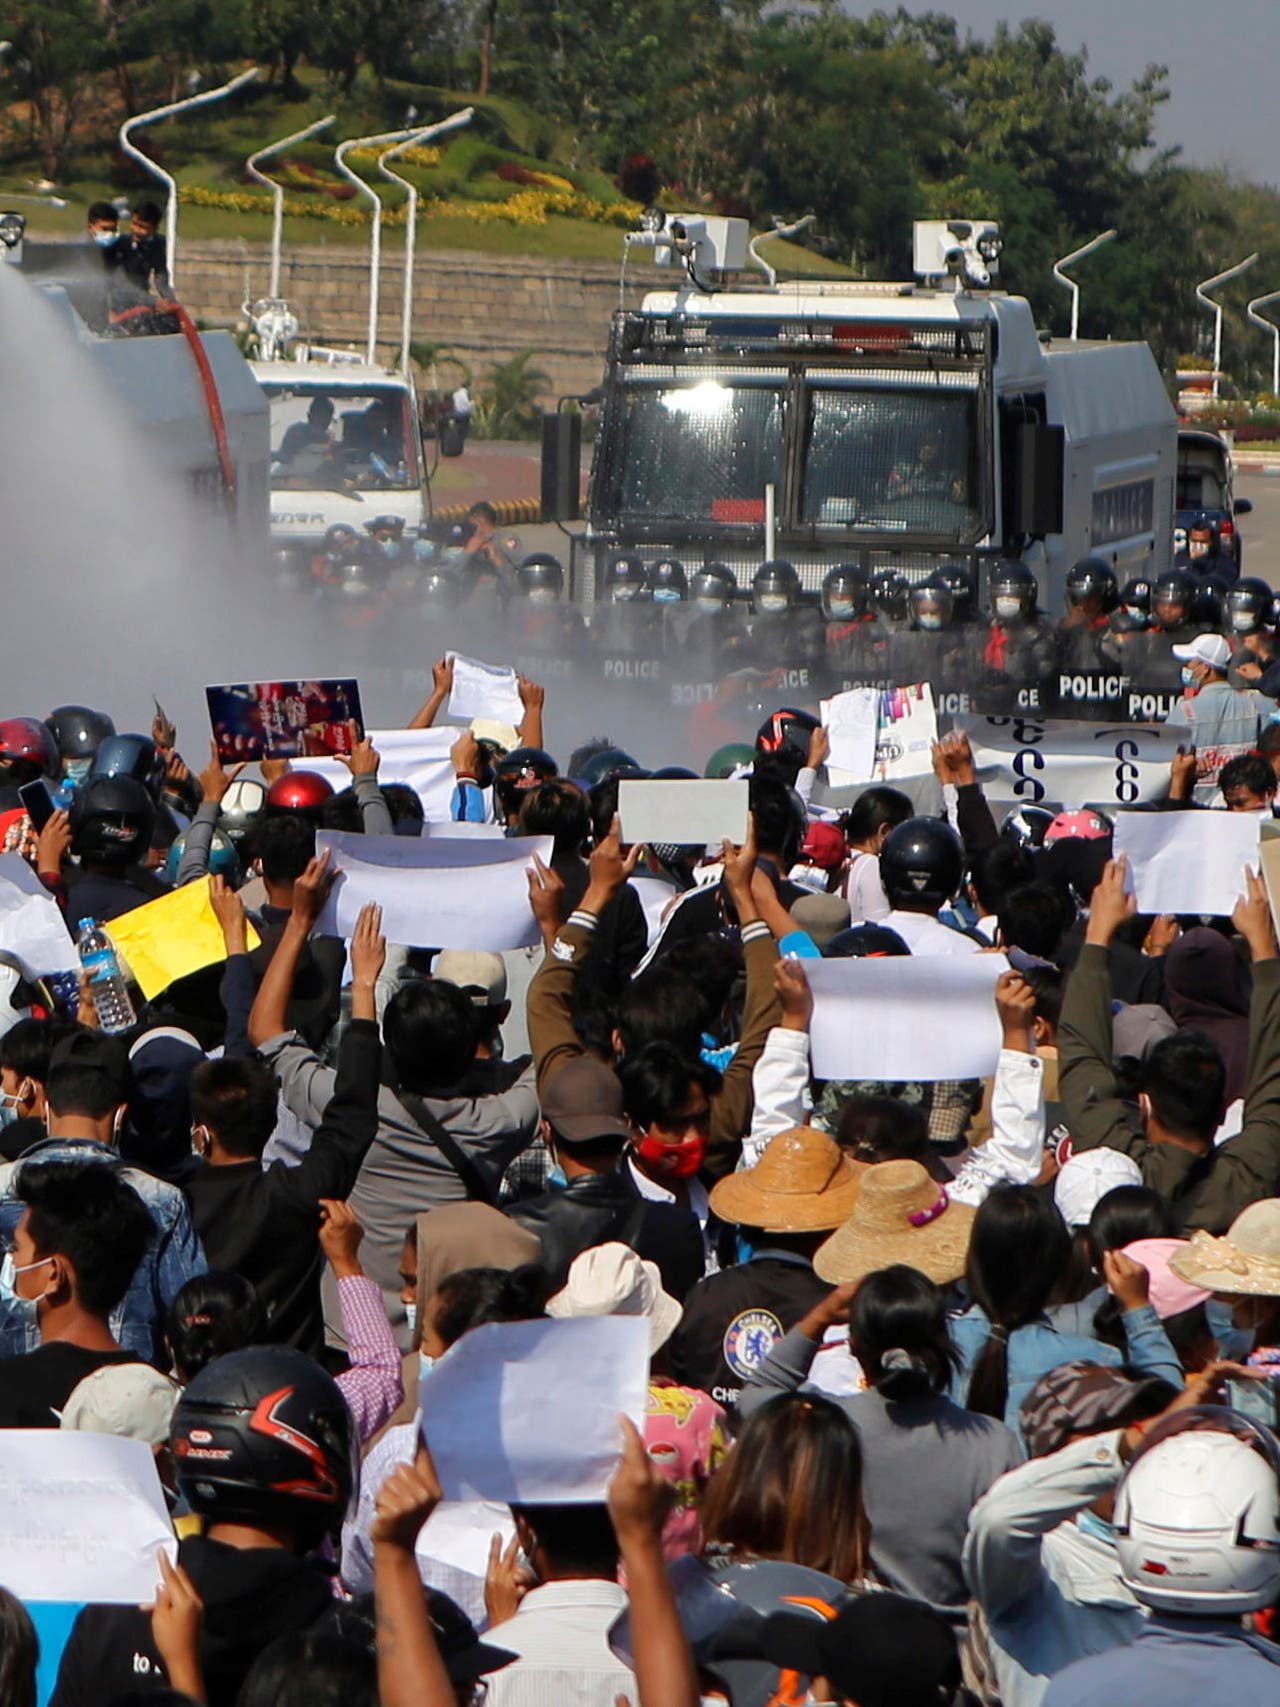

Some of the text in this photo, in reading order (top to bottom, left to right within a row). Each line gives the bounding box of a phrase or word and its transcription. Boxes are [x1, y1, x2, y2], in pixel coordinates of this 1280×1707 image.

[604, 659, 660, 679] POLICE
[937, 693, 970, 713] ICE
[1129, 693, 1182, 717] POLI
[133, 1652, 150, 1673] to
